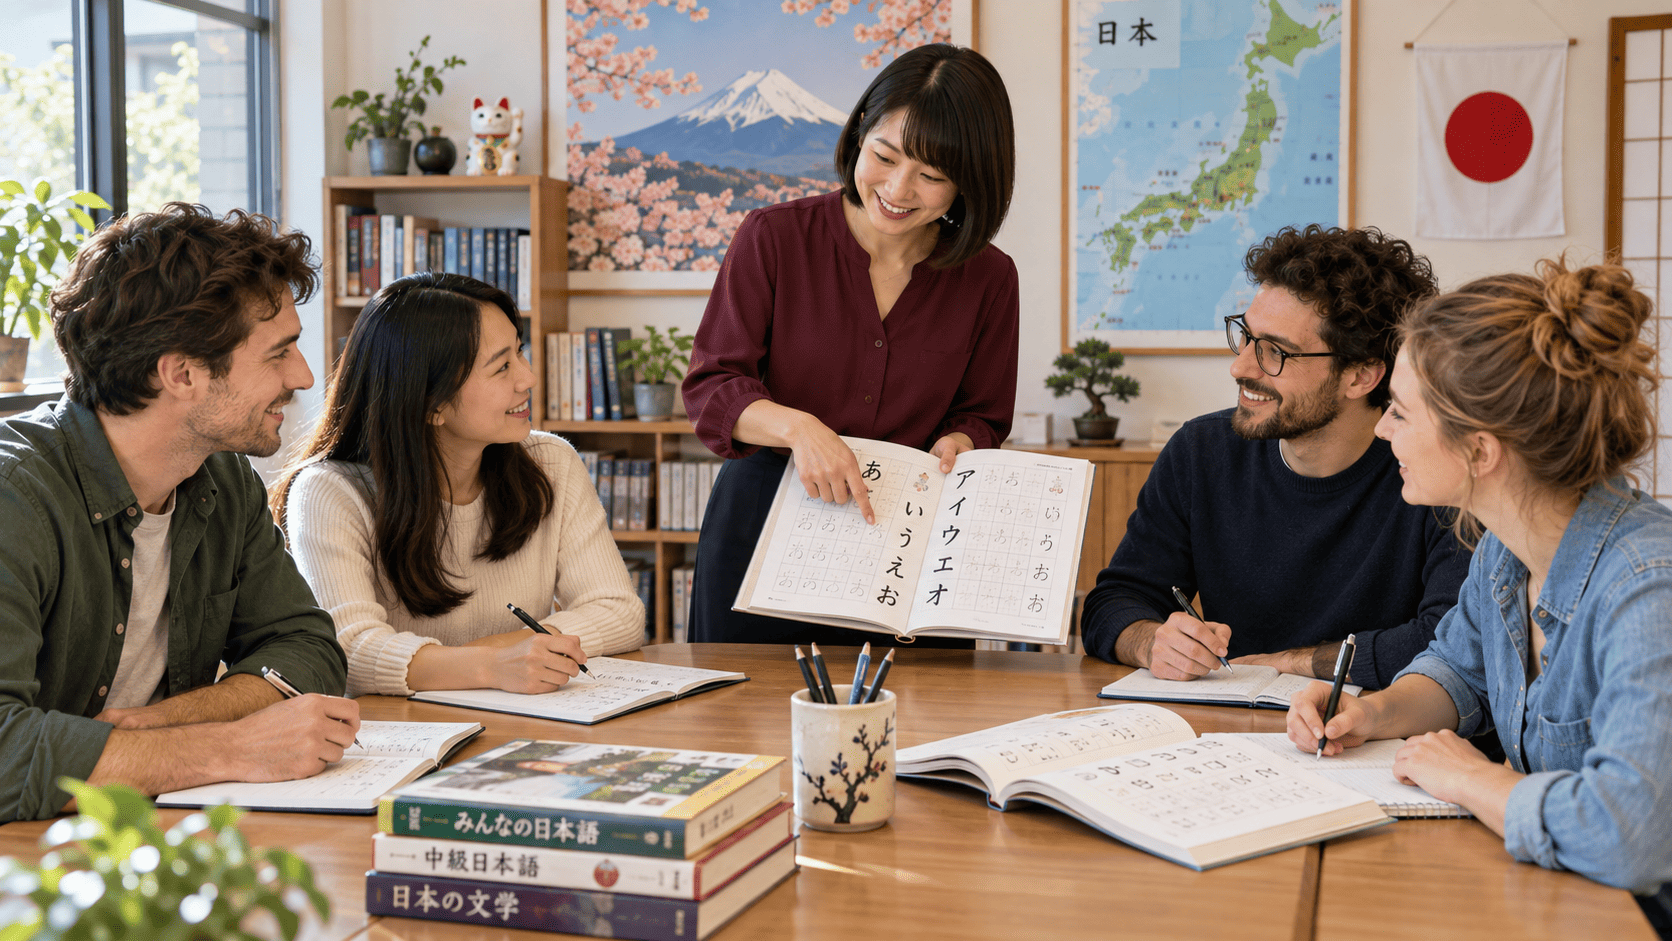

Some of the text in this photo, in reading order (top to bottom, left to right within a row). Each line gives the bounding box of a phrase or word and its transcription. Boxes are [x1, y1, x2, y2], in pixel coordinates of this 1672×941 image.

[1098, 17, 1157, 46] 日本
[926, 469, 975, 605] アイウエオ
[453, 811, 599, 845] みんなの日本語
[425, 846, 539, 878] 中級日本語
[392, 885, 520, 921] 日本の文学
